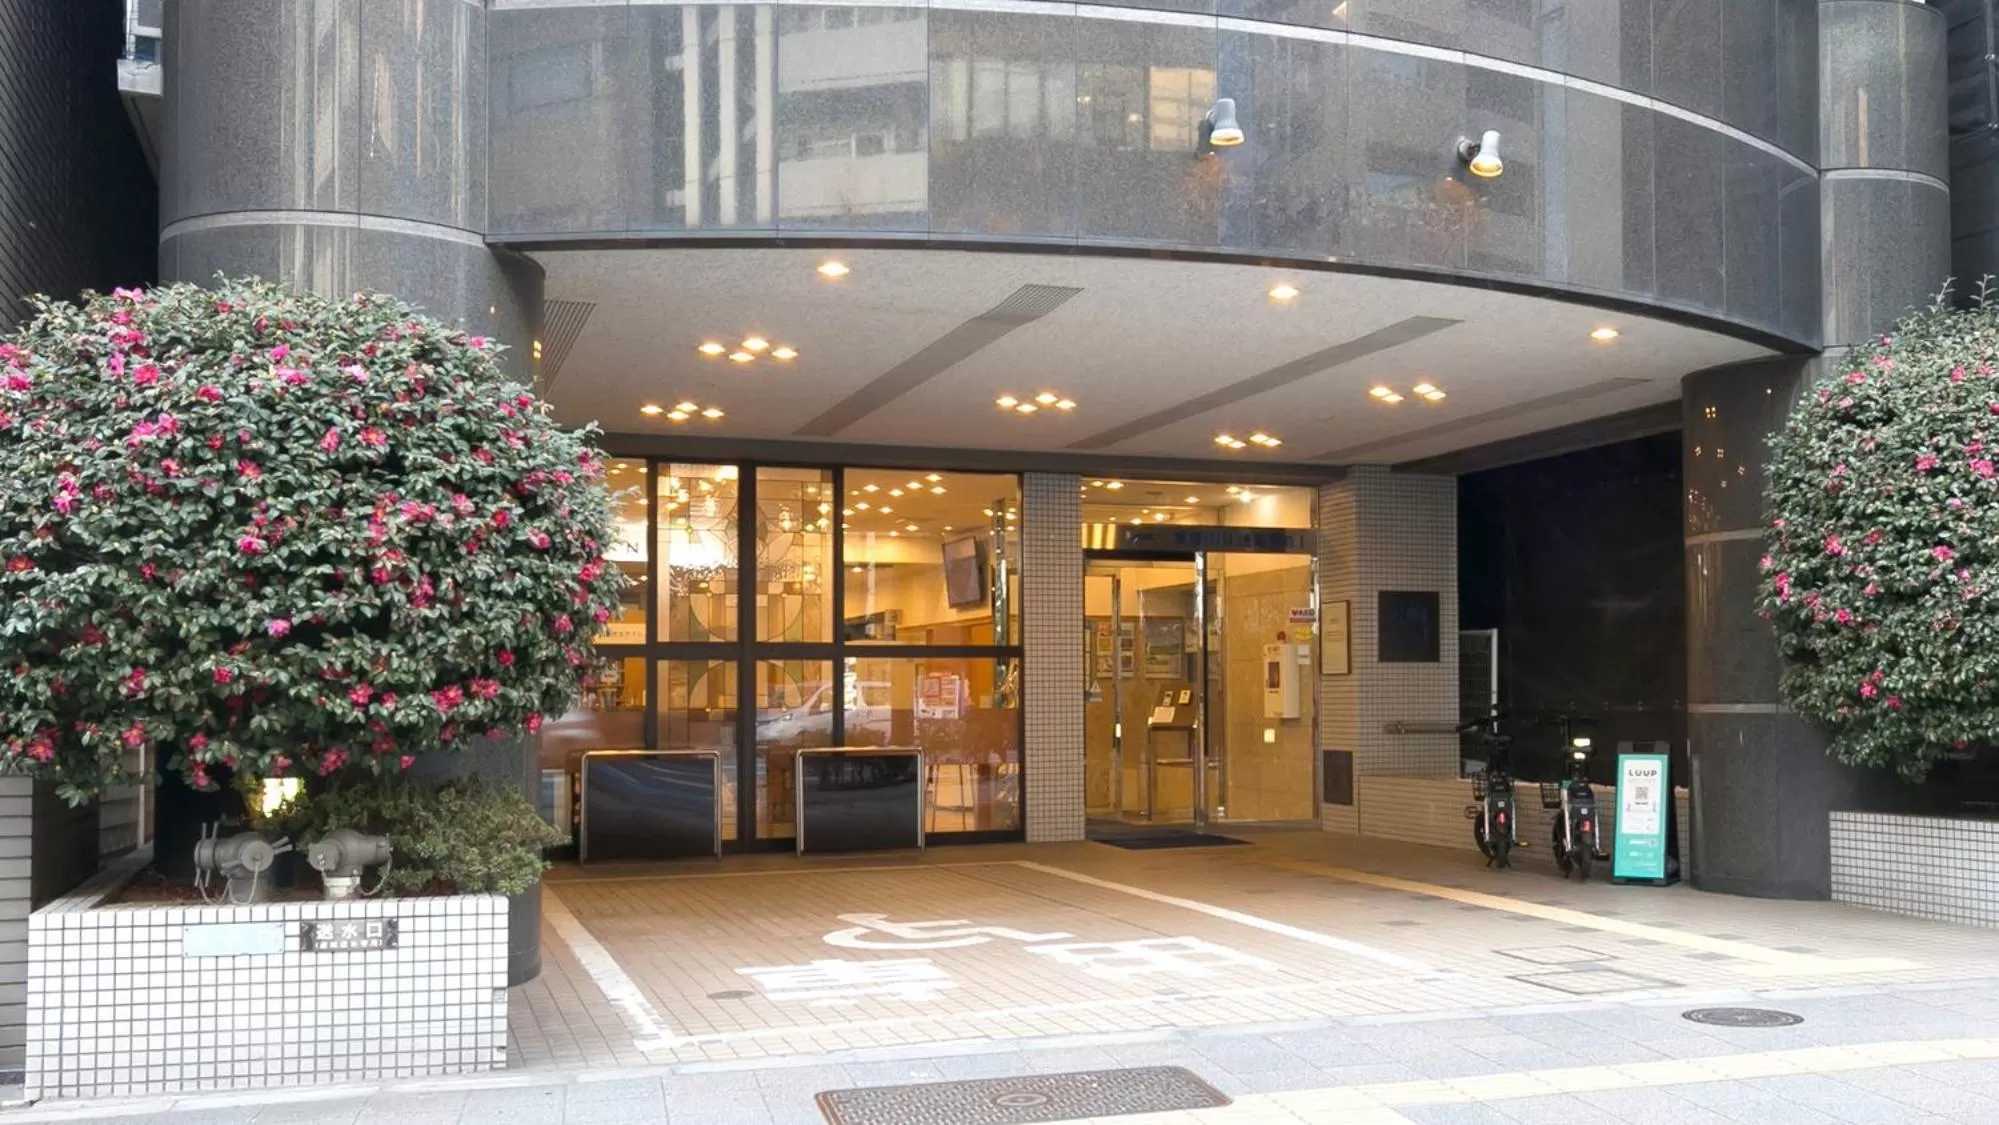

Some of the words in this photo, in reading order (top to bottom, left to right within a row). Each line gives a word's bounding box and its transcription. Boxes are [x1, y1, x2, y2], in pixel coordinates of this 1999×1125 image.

[1628, 769, 1658, 777] LUUP
[316, 921, 382, 940] 送水口
